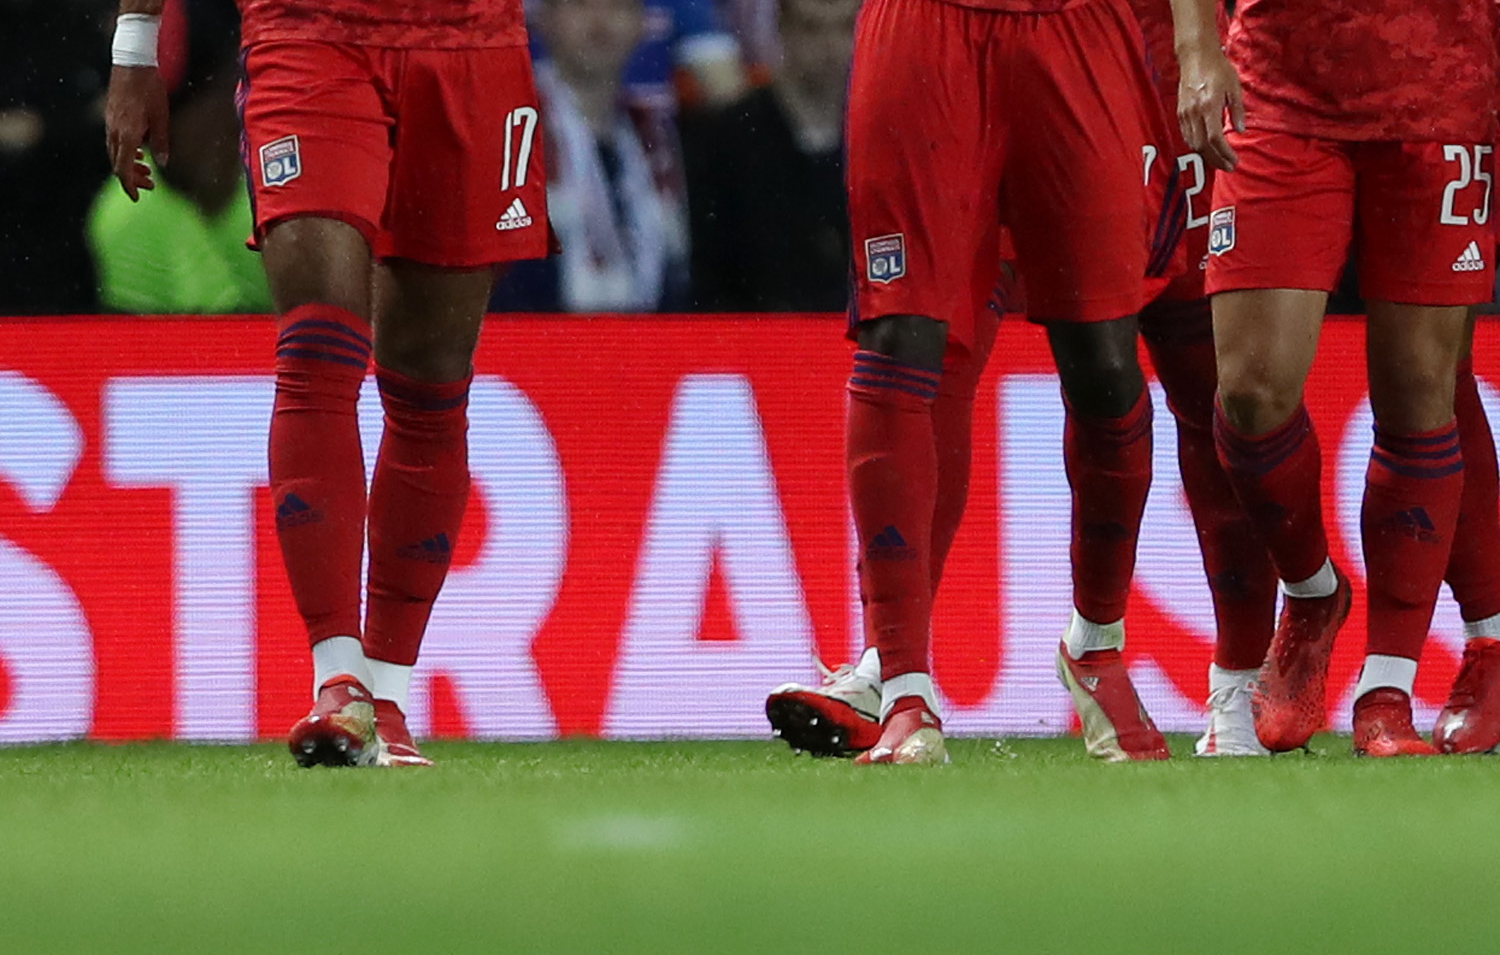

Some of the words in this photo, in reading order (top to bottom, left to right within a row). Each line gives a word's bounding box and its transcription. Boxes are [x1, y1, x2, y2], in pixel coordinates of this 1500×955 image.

[501, 106, 538, 191] 17
[1440, 145, 1492, 225] 25
[496, 216, 532, 230] adidas
[1452, 259, 1485, 271] adidas
